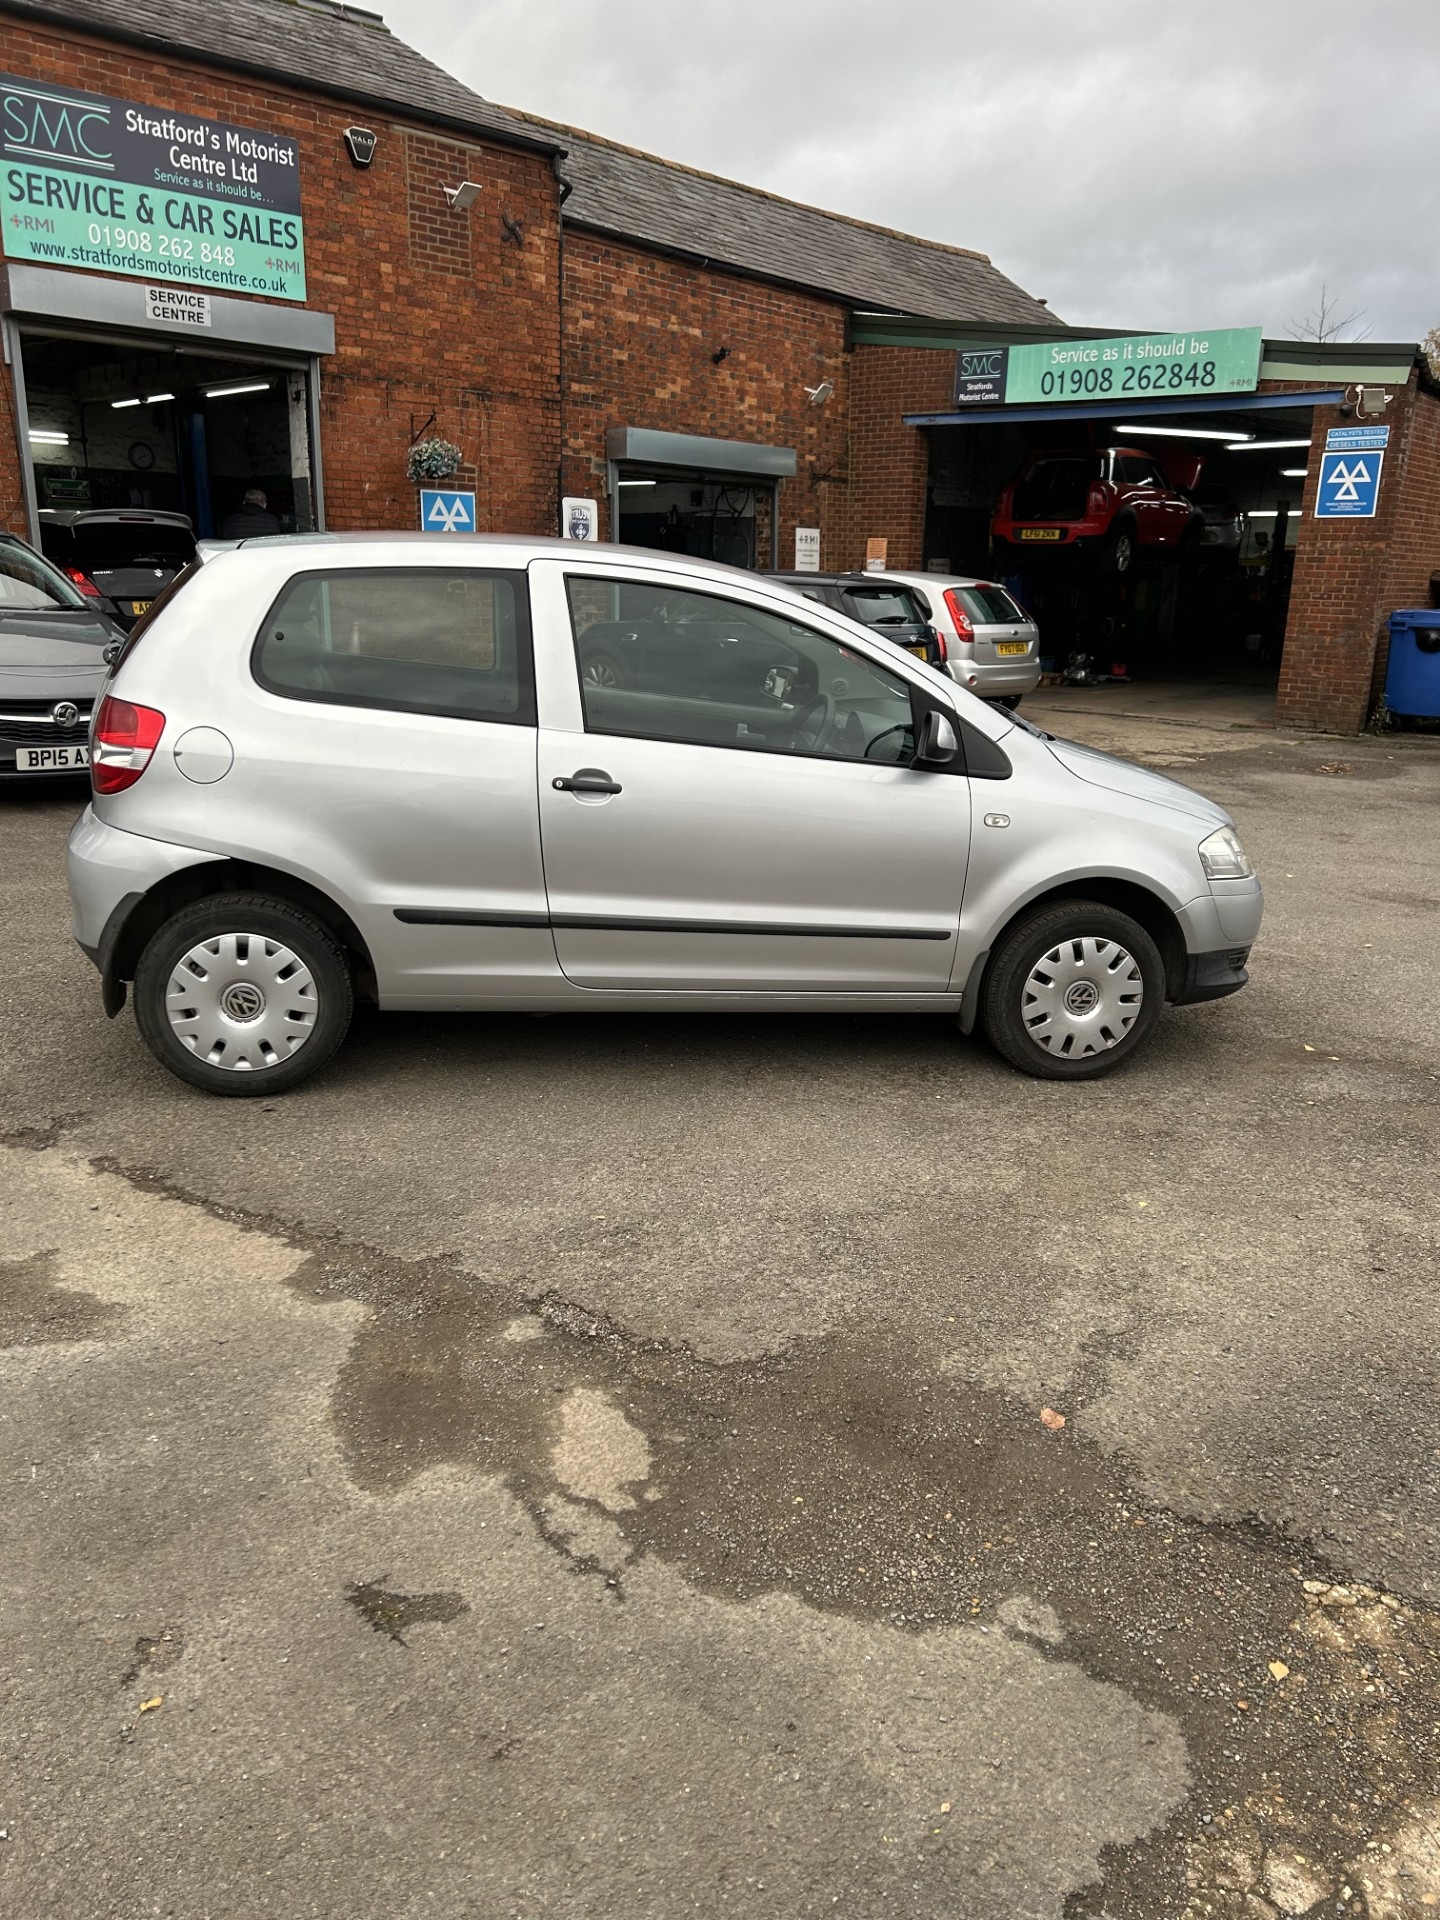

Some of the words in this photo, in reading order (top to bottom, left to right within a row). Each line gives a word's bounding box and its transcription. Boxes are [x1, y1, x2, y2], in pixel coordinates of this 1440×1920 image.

[4, 96, 112, 159] SMC
[125, 109, 221, 150] Stratford's
[225, 131, 295, 166] Motorist
[169, 145, 226, 177] Centre
[231, 158, 258, 184] Ltd
[154, 167, 190, 187] Service
[192, 178, 204, 190] as
[206, 178, 214, 192] it
[215, 181, 248, 199] should
[7, 169, 126, 220] SERVICE
[136, 193, 155, 225] &
[164, 198, 215, 236] CAR
[222, 209, 298, 250] SALES
[88, 223, 152, 254] 01908
[158, 235, 195, 260] 262
[200, 242, 236, 267] 848
[30, 241, 287, 293] www.stratfordsmotoristcentre.co.uk
[149, 289, 206, 308] SERVICE
[152, 306, 205, 324] CENTRE
[961, 355, 1002, 376] SMC
[1051, 345, 1099, 364] Service
[1102, 347, 1119, 361] as
[1123, 343, 1133, 359] it
[1136, 338, 1186, 359] should
[1190, 338, 1209, 355] be
[1041, 367, 1113, 396] 01908
[1121, 360, 1216, 391] 262848
[958, 393, 981, 402] Motorist
[981, 391, 1000, 400] Centre
[28, 749, 69, 767] BP15
